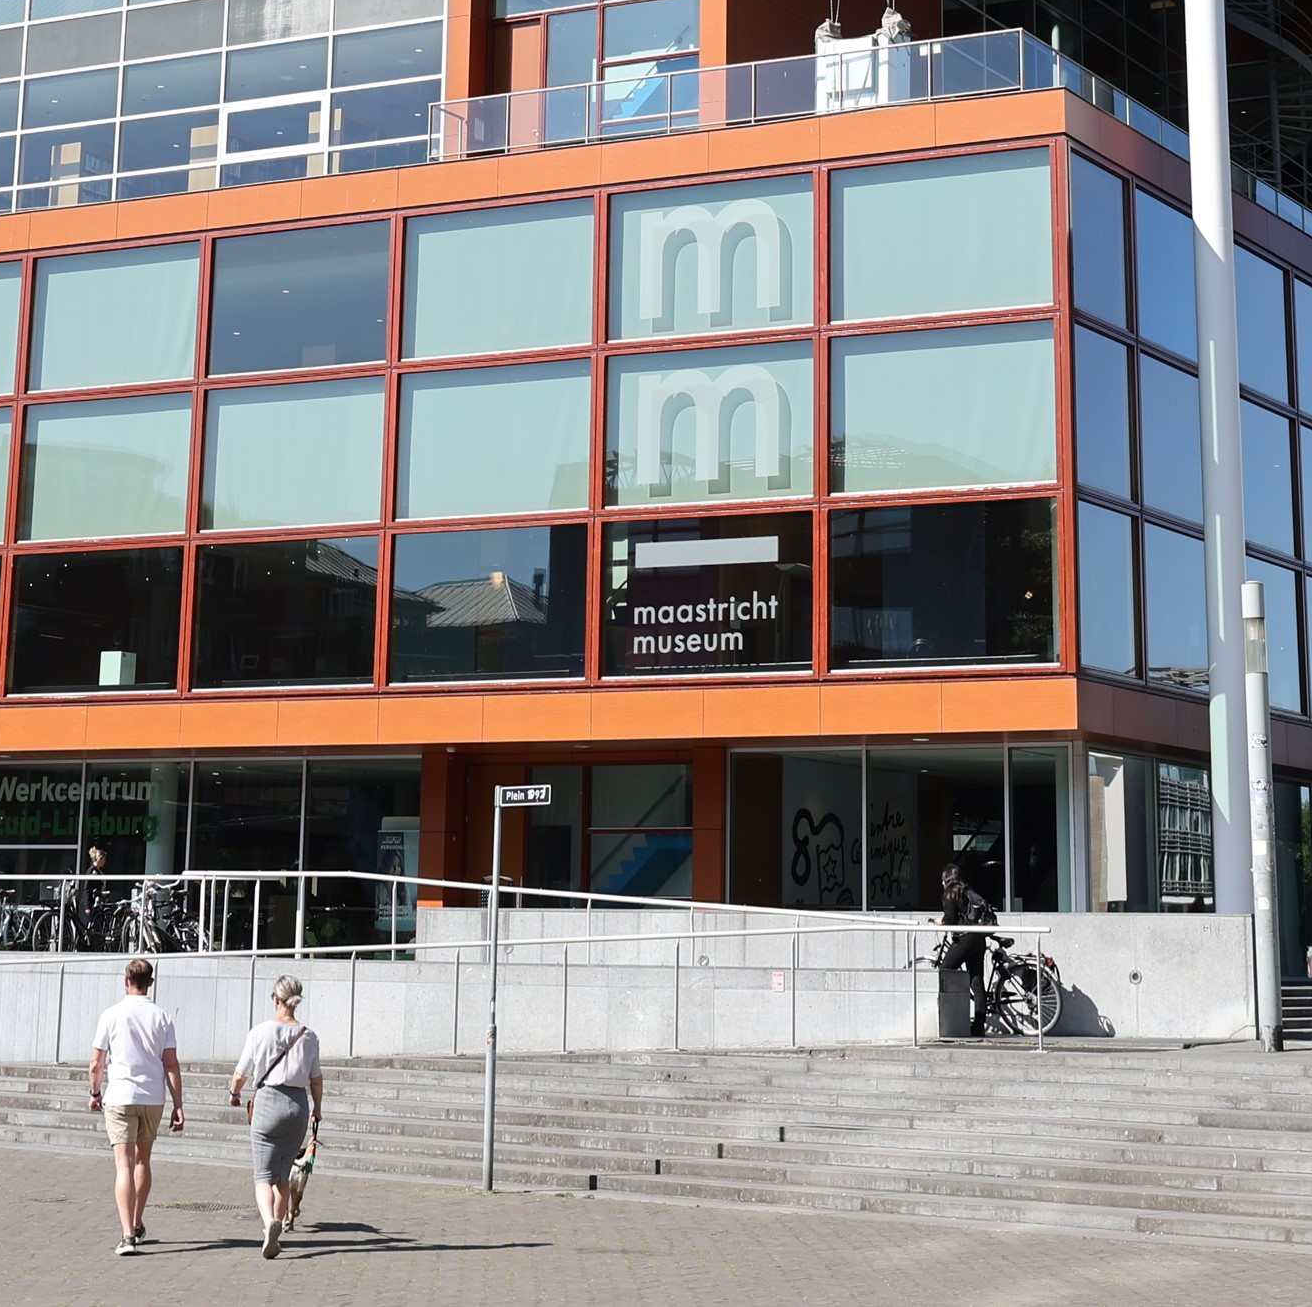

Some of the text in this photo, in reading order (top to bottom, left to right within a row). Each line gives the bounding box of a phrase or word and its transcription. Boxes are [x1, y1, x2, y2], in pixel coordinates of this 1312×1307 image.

[632, 591, 779, 625] maastricht
[632, 631, 744, 655] museum
[506, 790, 525, 801] Plein
